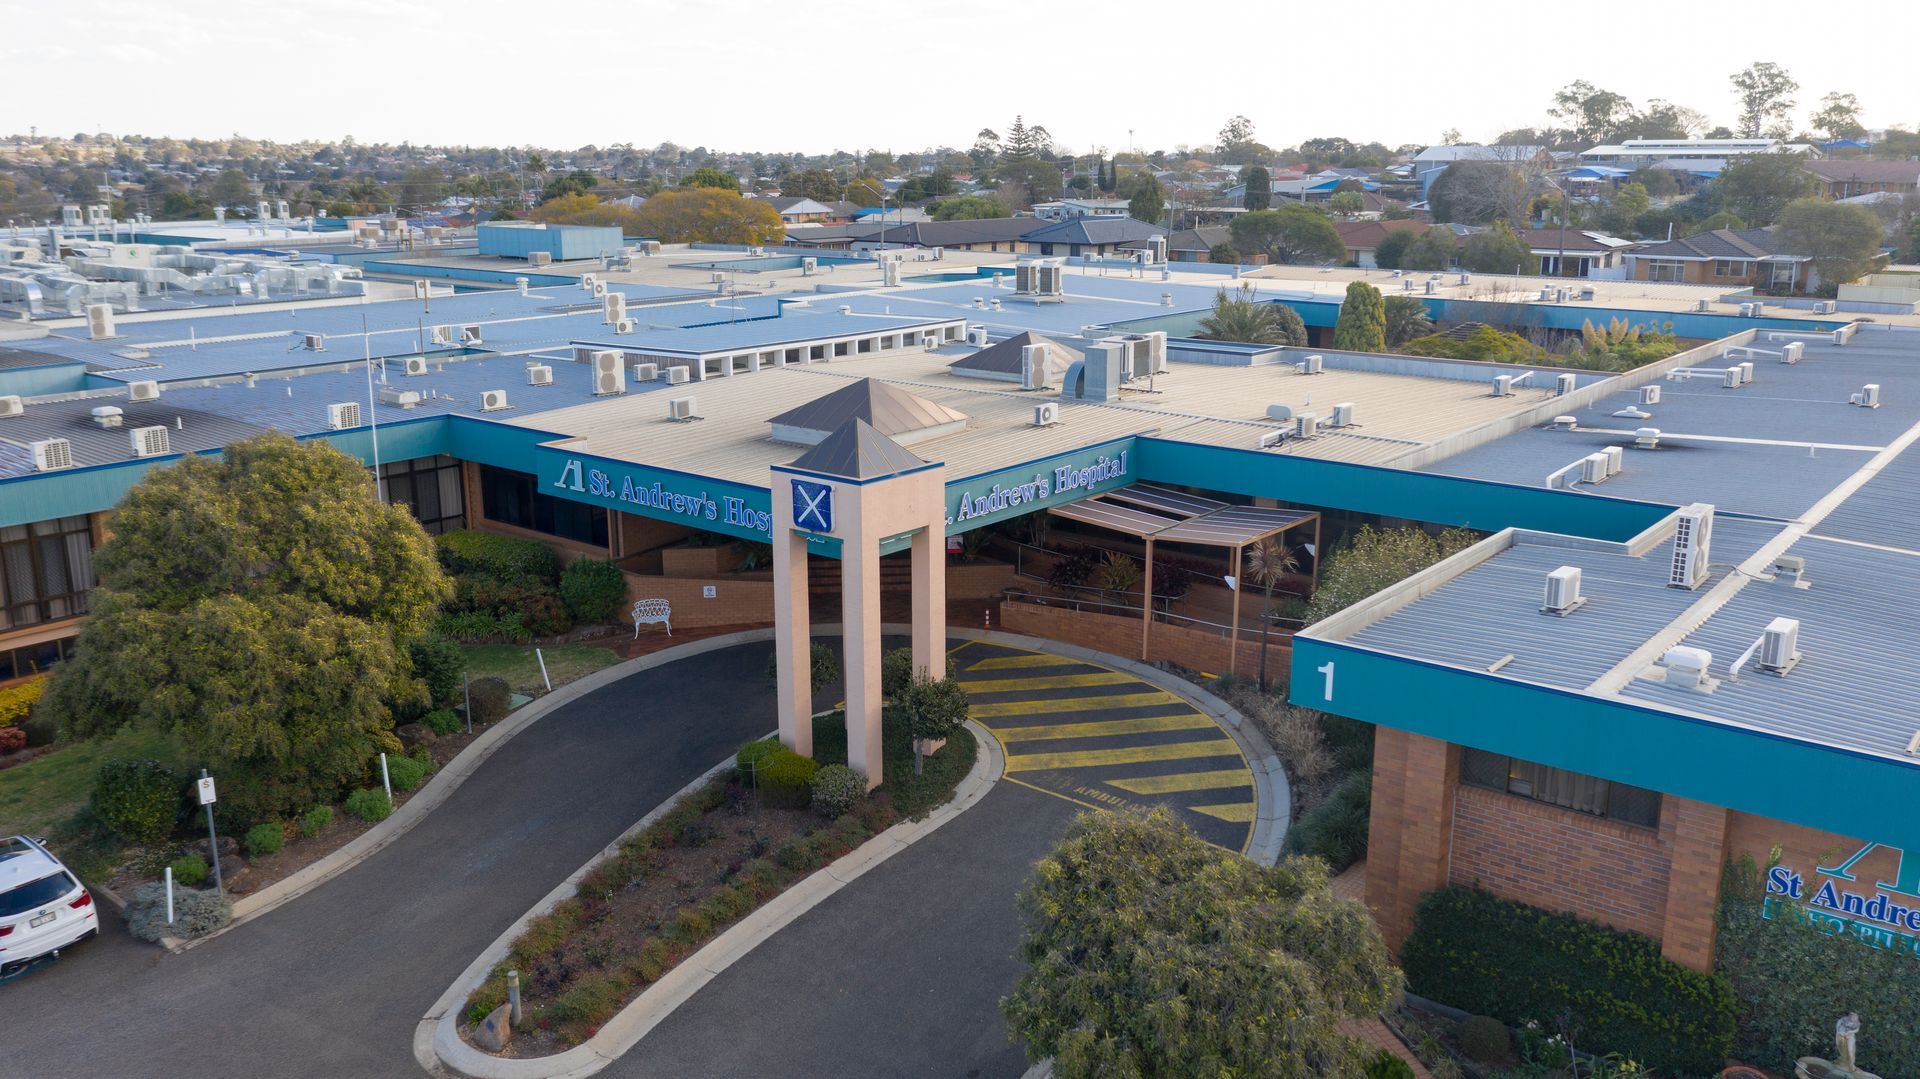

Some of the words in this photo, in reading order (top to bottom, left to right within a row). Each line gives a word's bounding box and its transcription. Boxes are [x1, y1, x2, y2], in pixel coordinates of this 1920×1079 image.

[589, 469, 615, 498] St.
[620, 475, 717, 520] Andrew's
[958, 473, 1049, 521] Andrew's
[1055, 450, 1127, 495] Hospital
[1317, 661, 1335, 701] 1
[1766, 866, 1803, 899] St
[1810, 879, 1920, 931] Andre
